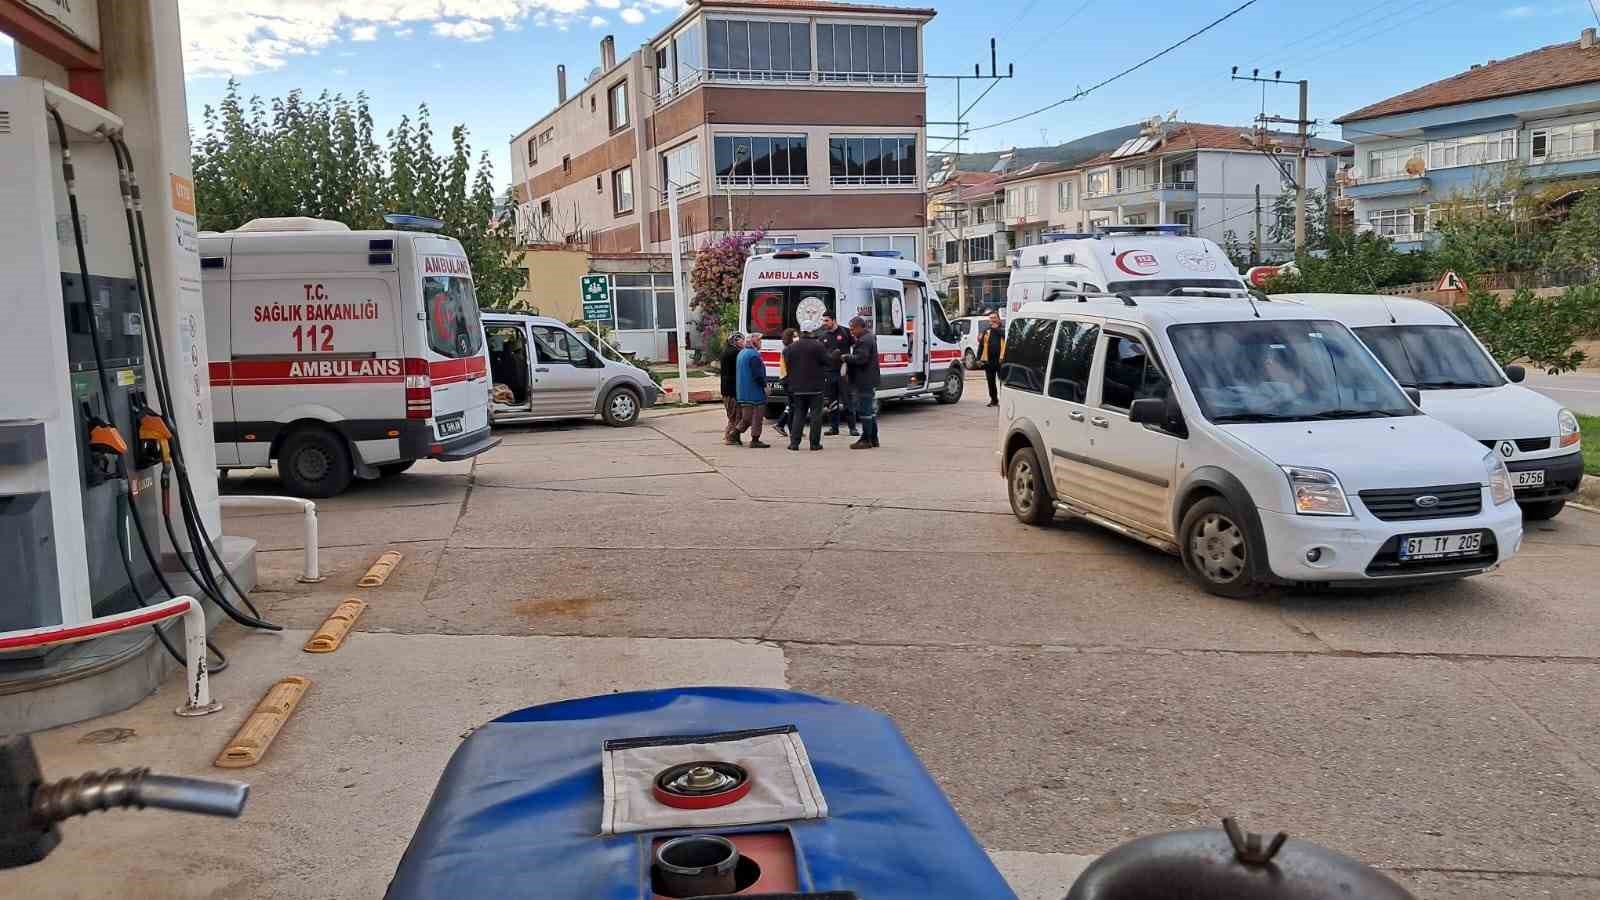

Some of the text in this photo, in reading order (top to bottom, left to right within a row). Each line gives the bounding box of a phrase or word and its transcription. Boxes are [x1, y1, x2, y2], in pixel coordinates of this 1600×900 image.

[758, 271, 819, 280] AMBULANS
[304, 284, 328, 300] T.C.
[254, 299, 379, 322] SAĞLIK BAKANLIĞI
[292, 325, 334, 352] 112
[290, 360, 401, 376] AMBULANS
[1519, 472, 1542, 484] 6756
[1408, 534, 1480, 554] 61 TY 205
